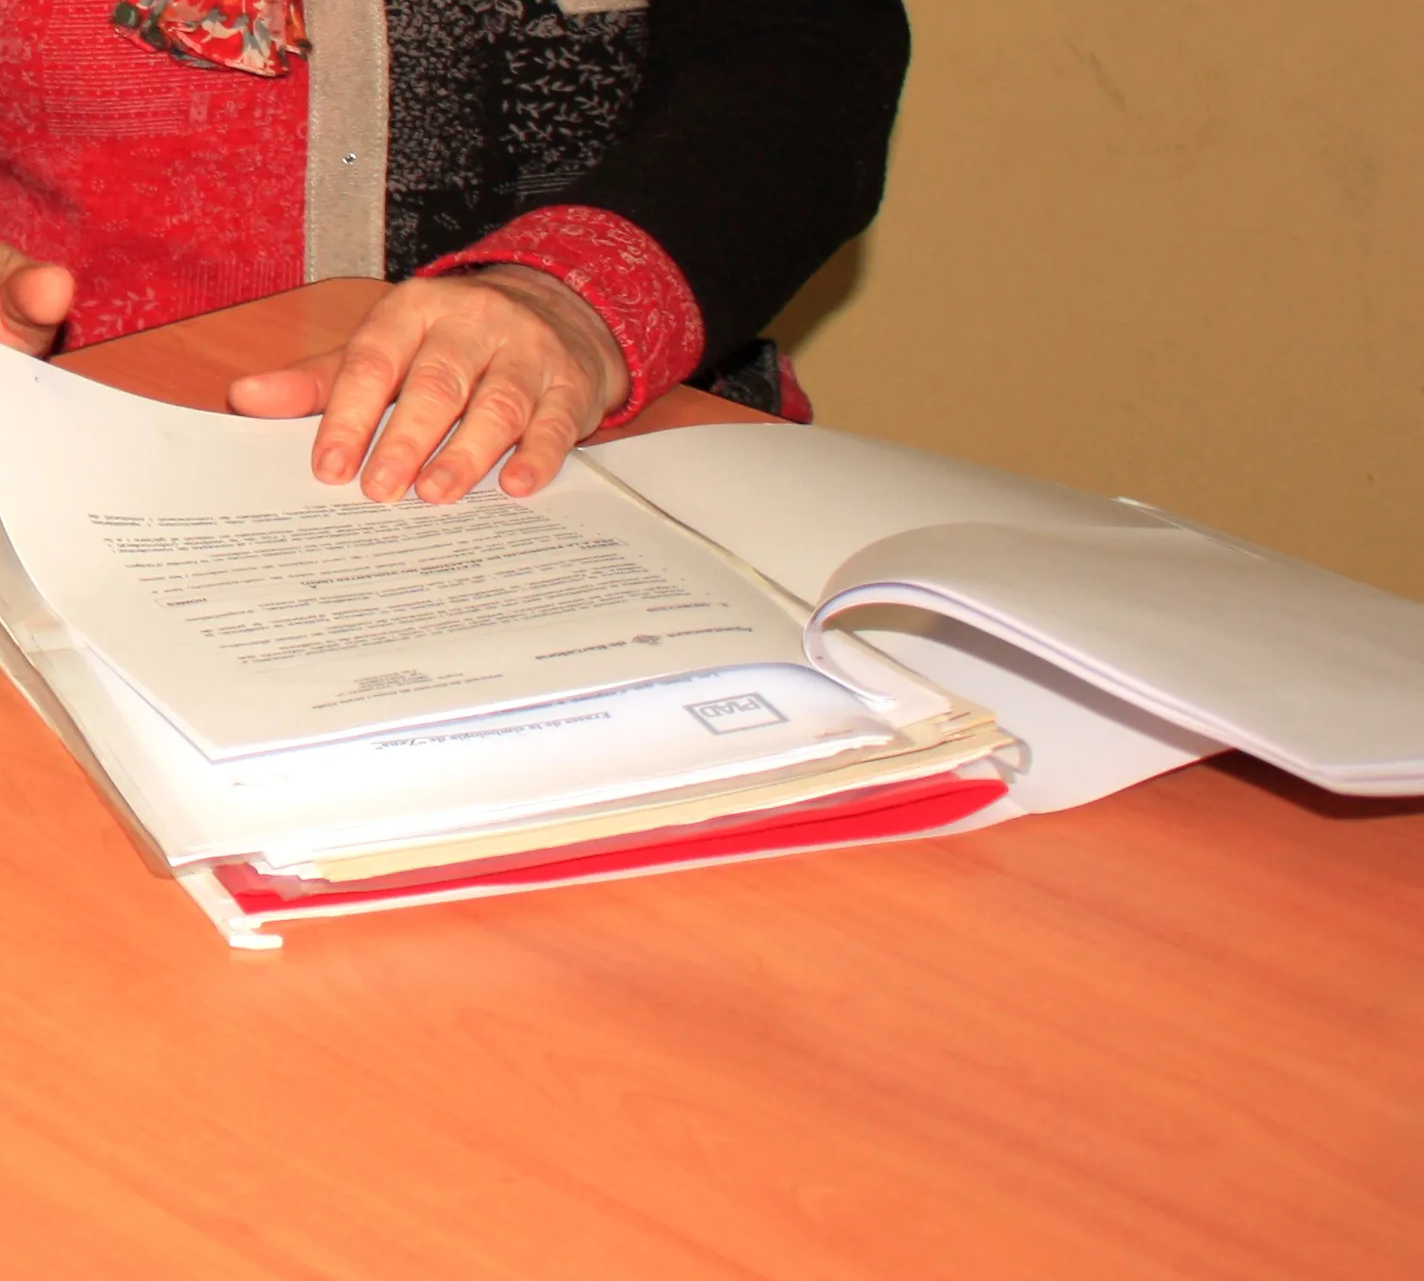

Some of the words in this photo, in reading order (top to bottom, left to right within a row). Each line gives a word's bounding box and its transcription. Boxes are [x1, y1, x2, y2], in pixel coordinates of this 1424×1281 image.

[608, 640, 626, 648] de
[534, 644, 608, 660] Barcelona
[700, 698, 761, 719] PIAD
[545, 720, 561, 728] de
[429, 735, 446, 743] de
